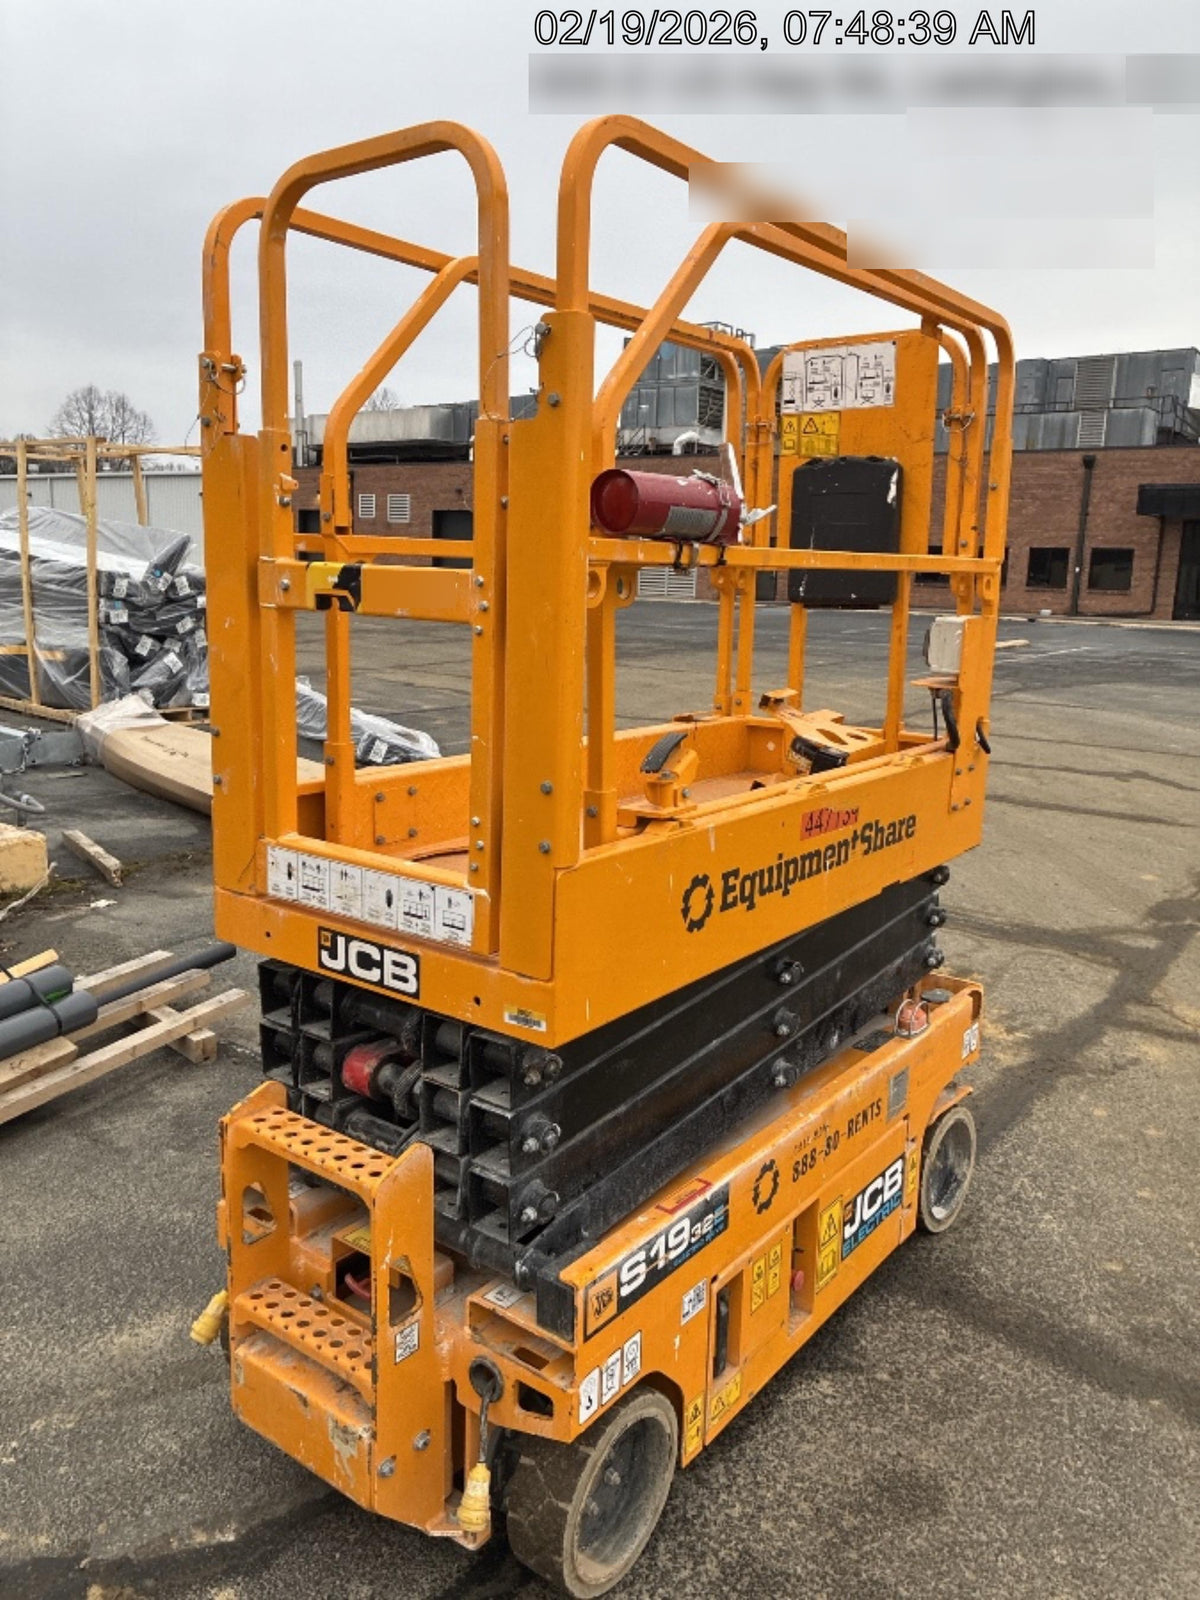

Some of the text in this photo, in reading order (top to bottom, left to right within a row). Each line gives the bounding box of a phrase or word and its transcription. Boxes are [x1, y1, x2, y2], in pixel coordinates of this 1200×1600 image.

[720, 814, 916, 912] EquipmentShare
[320, 934, 418, 993] JCB
[842, 1190, 902, 1258] ELECTRIC
[844, 1158, 904, 1239] JCB
